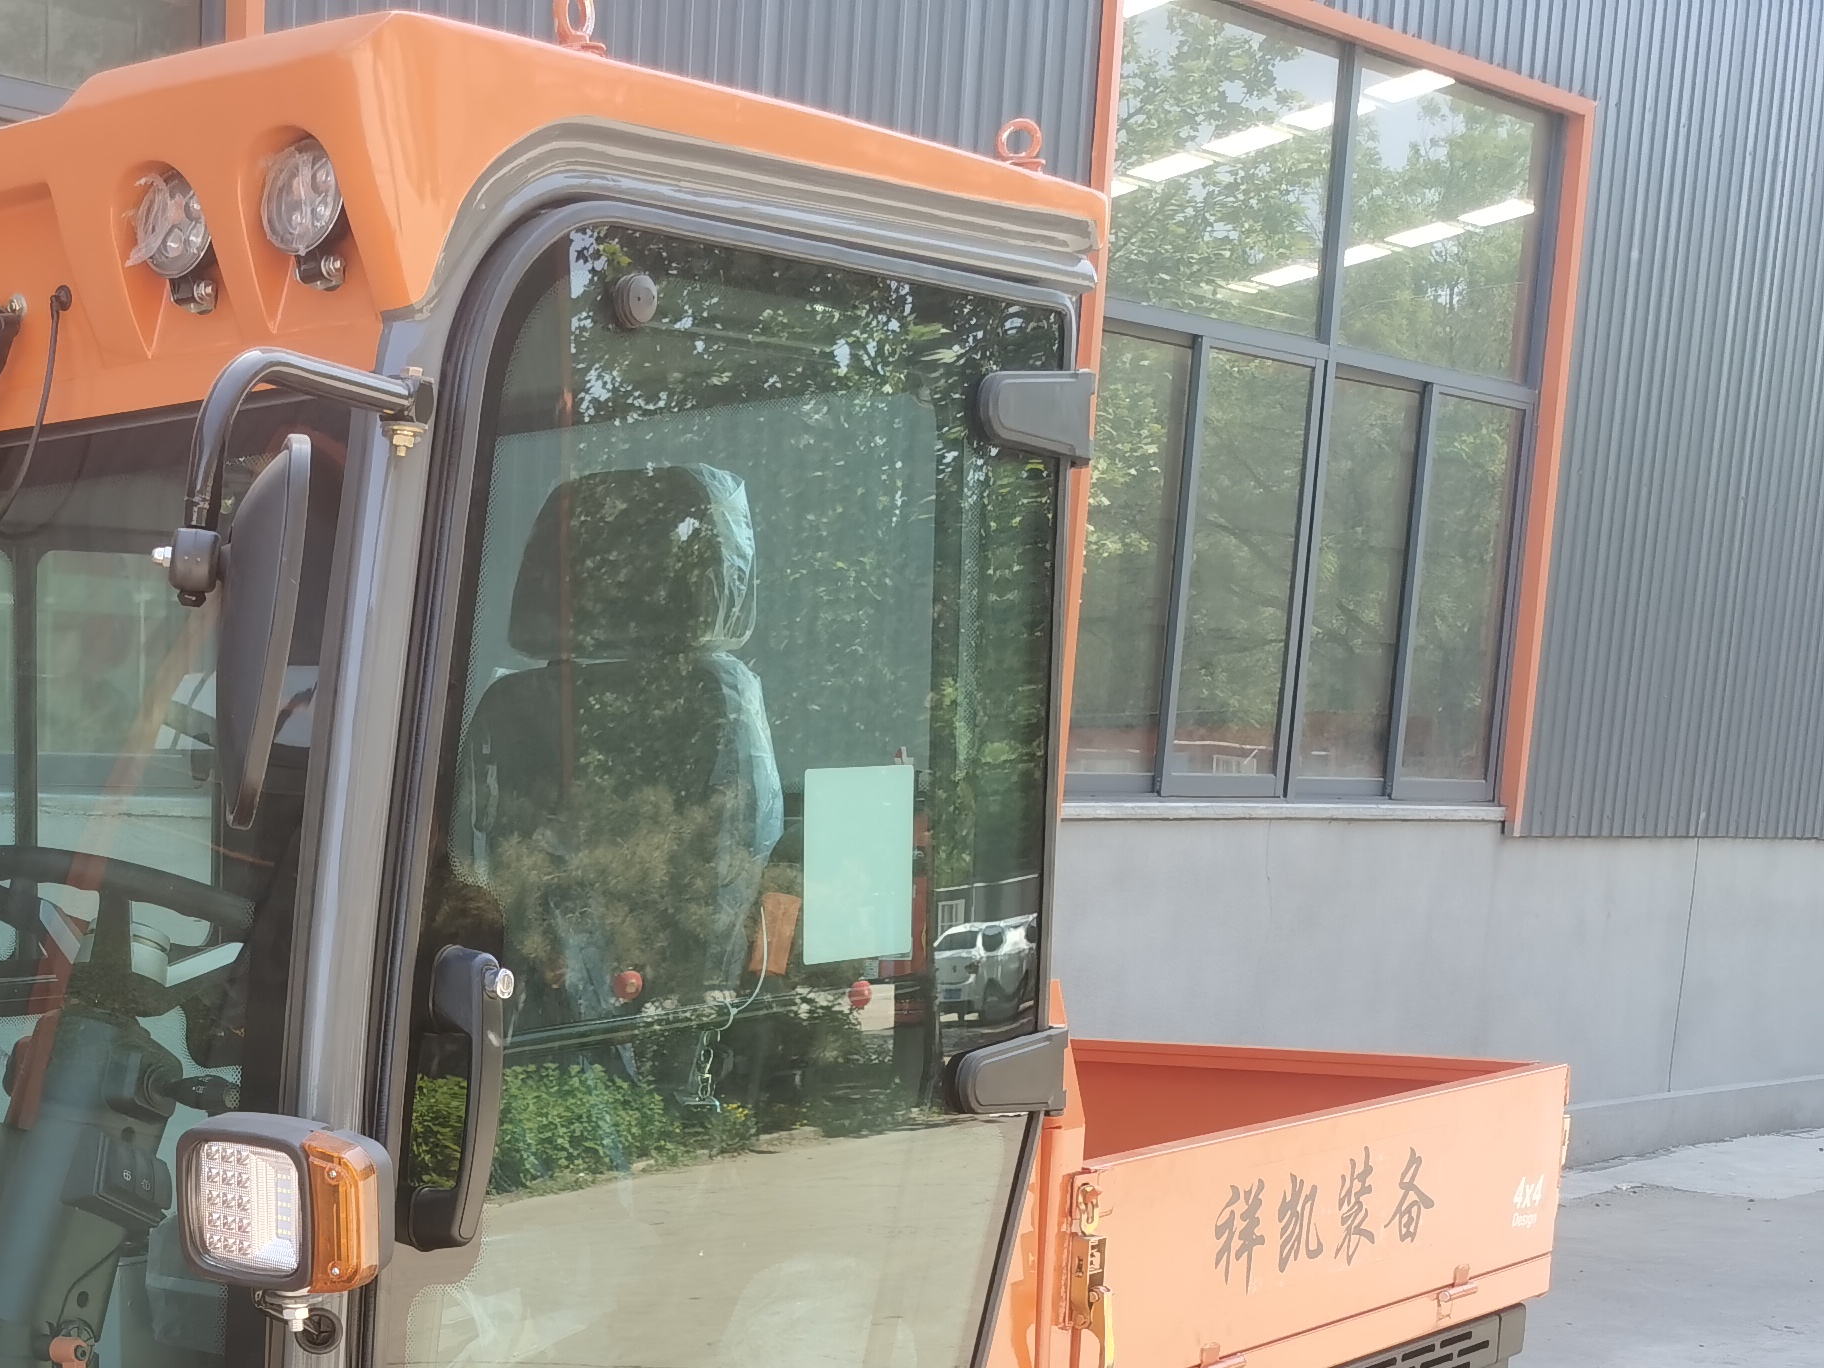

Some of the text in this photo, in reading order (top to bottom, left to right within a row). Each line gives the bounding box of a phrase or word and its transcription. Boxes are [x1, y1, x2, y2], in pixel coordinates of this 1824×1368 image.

[1512, 1174, 1545, 1209] 4x4
[1214, 1146, 1435, 1294] 祥凯装备
[1511, 1211, 1538, 1229] Design
